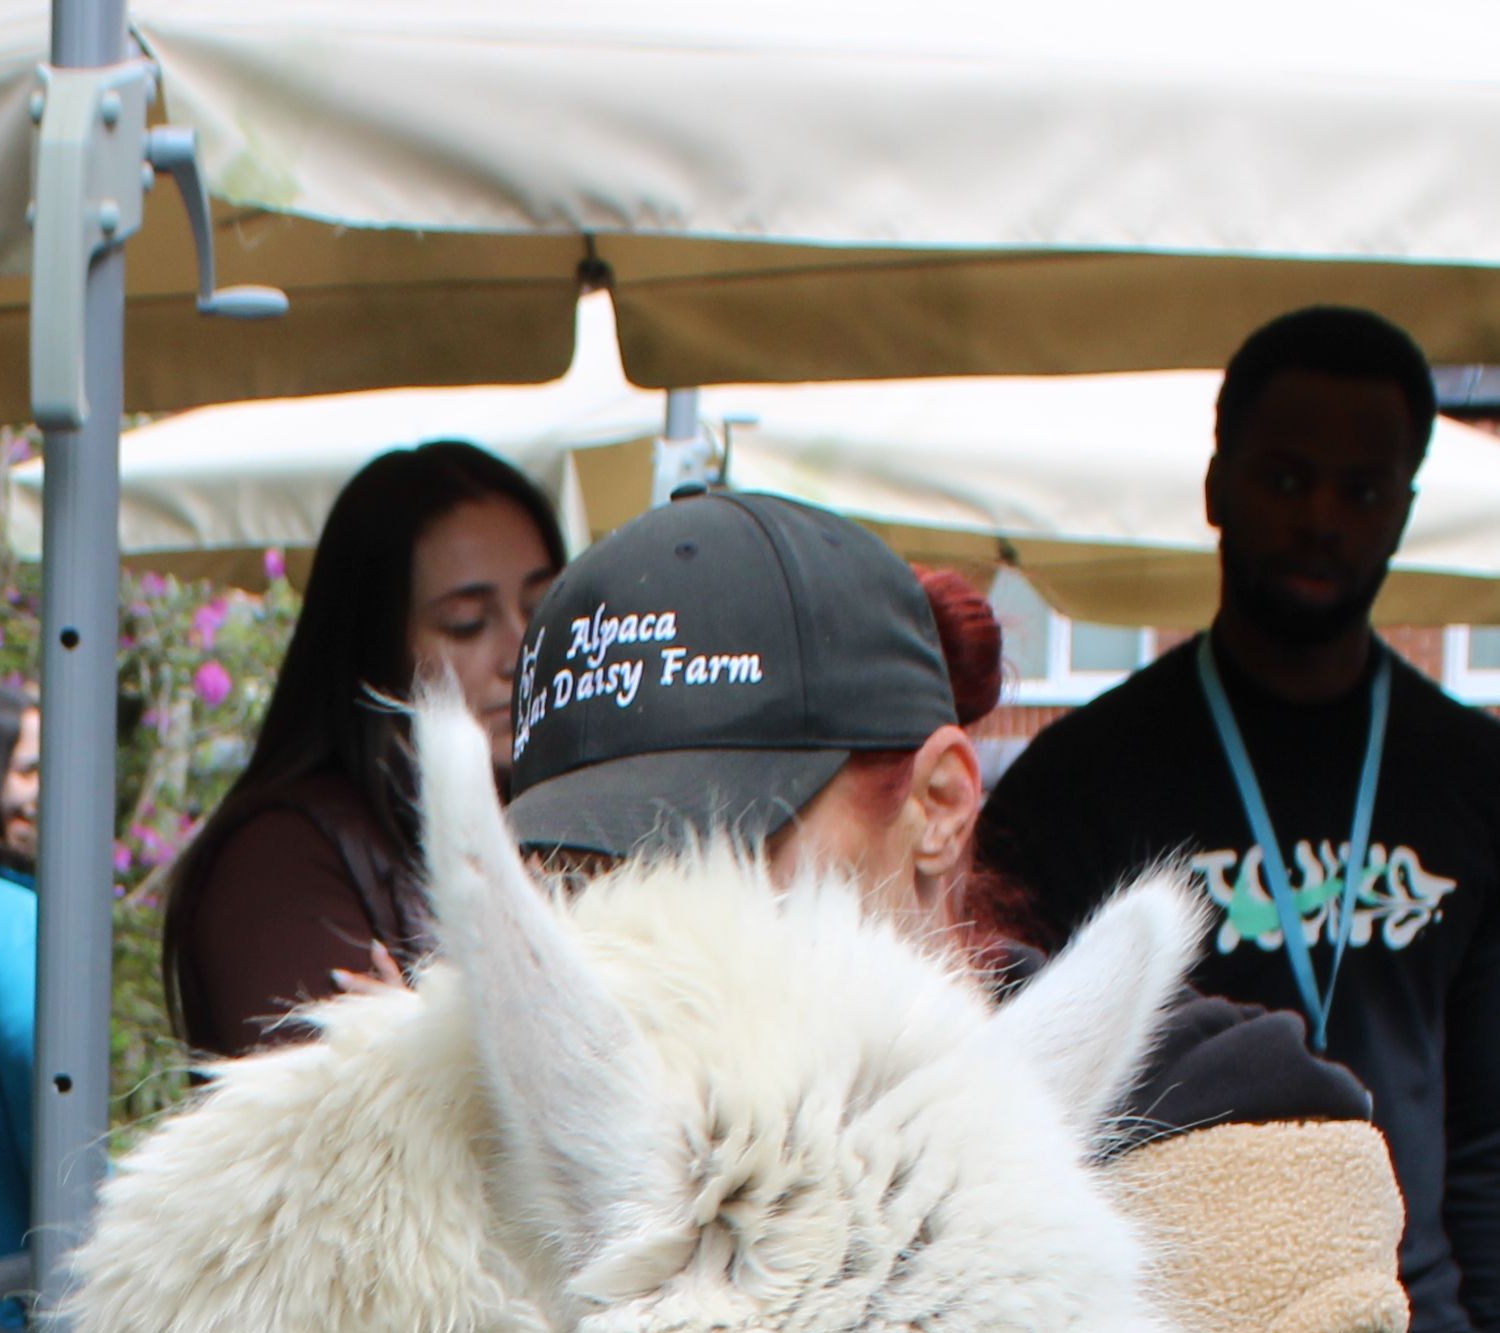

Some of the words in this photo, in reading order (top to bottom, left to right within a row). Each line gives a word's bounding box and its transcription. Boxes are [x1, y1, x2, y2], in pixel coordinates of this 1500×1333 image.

[567, 603, 677, 669] Alpaca
[553, 660, 644, 708] Daisy
[660, 647, 763, 685] Farm
